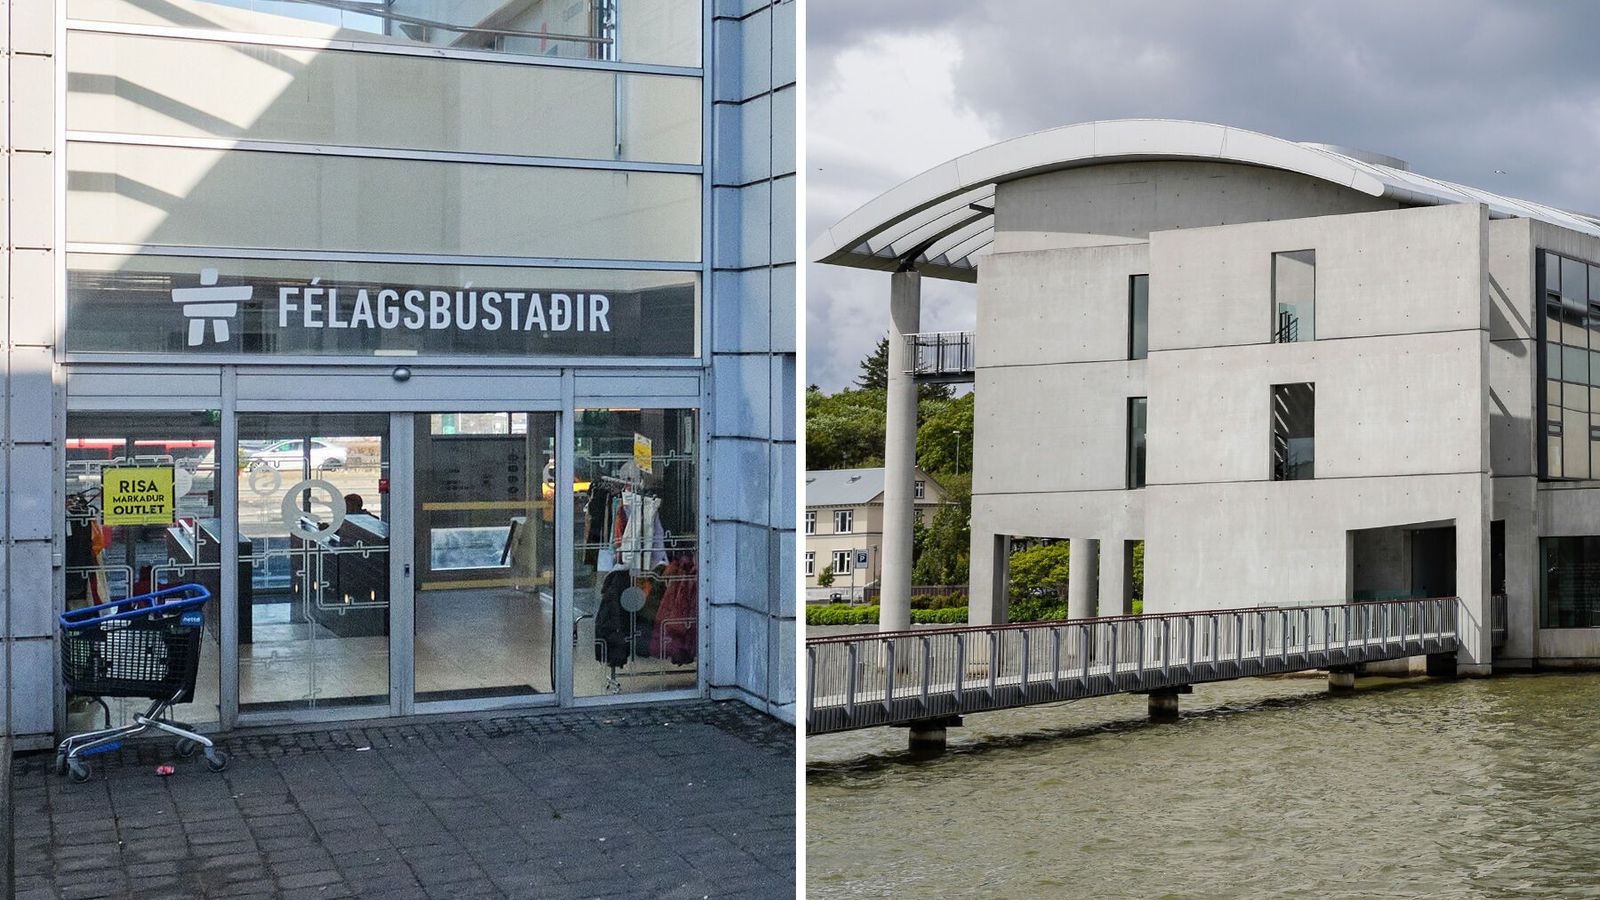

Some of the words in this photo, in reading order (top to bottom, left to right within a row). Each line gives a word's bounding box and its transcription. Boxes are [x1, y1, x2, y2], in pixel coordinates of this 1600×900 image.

[278, 277, 611, 333] FÉLAGSBÚSTAÐIR
[119, 480, 158, 493] RISA
[113, 505, 165, 515] OUTLET
